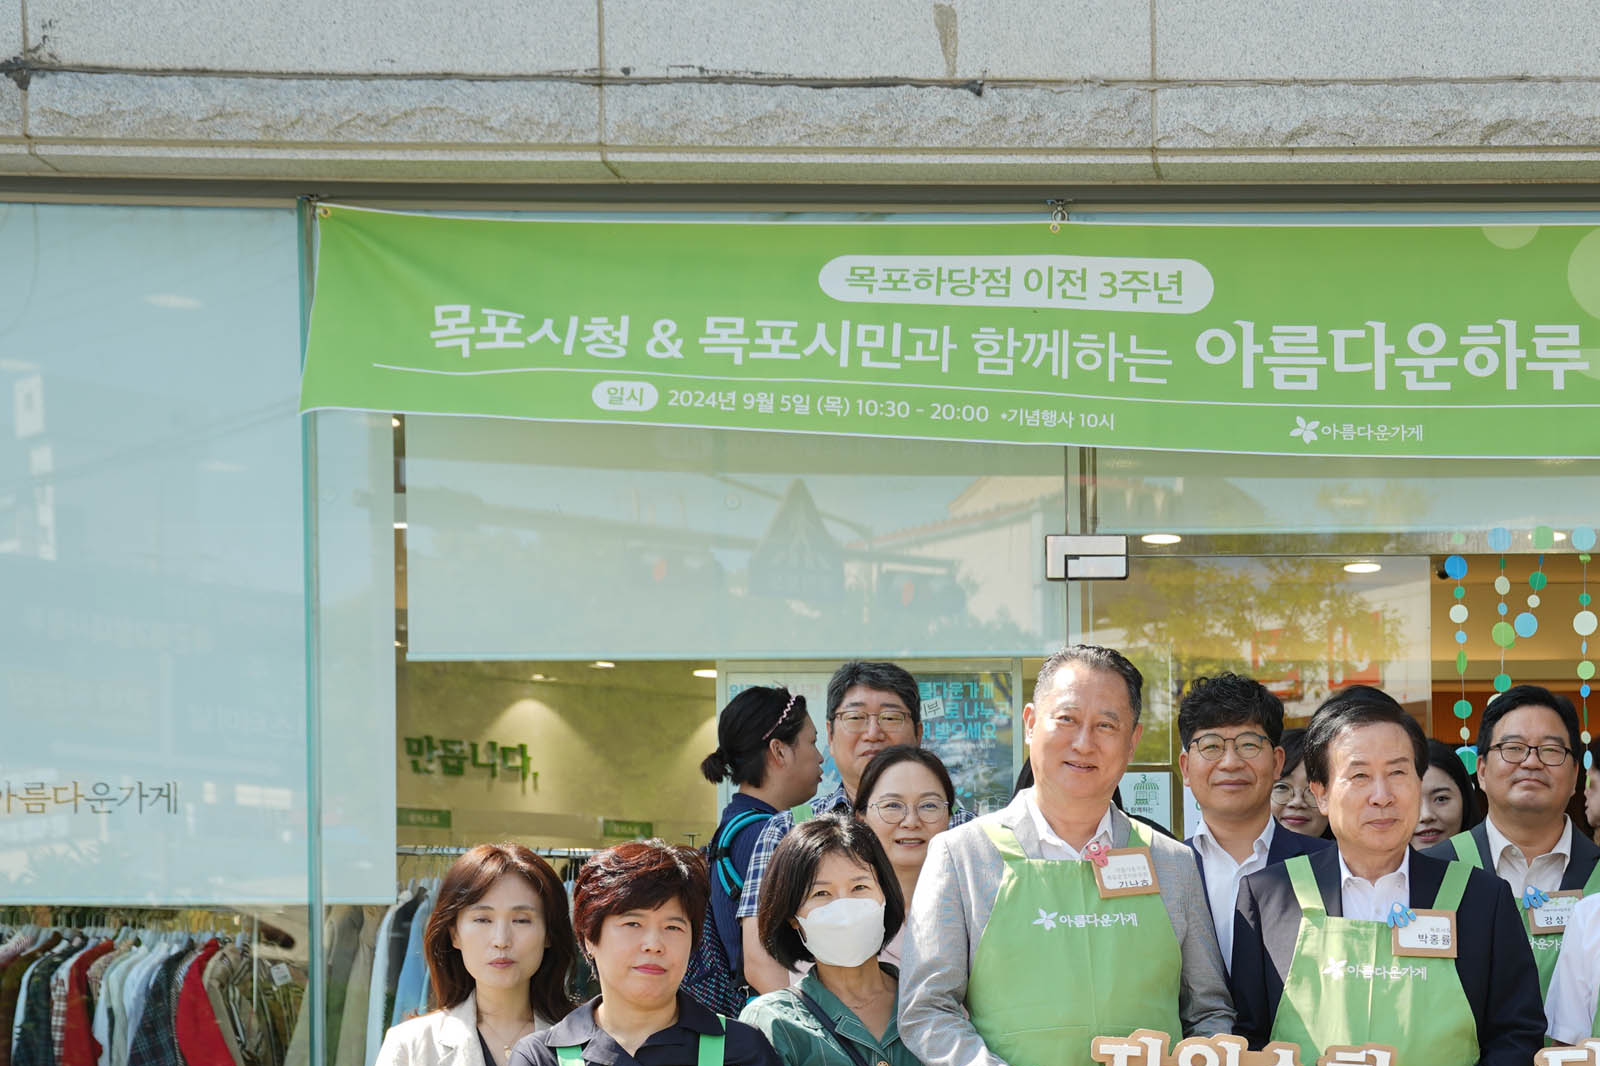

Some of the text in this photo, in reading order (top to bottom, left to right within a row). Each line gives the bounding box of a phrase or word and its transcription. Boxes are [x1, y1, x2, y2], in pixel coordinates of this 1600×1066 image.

[845, 264, 1184, 305] 목포하당점 이전 3주년
[429, 303, 1591, 392] 목포시청 & 목포시민과 함께하는 아름다운하루
[606, 385, 645, 407] 일시
[667, 389, 737, 412] 2024년
[743, 390, 774, 414] 9월
[779, 392, 811, 416] 5일
[815, 392, 850, 418] (목)
[856, 399, 909, 418] 10:30
[931, 402, 988, 423] 20:00
[1078, 410, 1115, 431] 10시
[1321, 422, 1423, 443] 아름다운가게
[918, 681, 993, 701] 름다운가게
[1058, 907, 1139, 929] 아름다운가게
[1346, 964, 1428, 983] 아름다운가게
